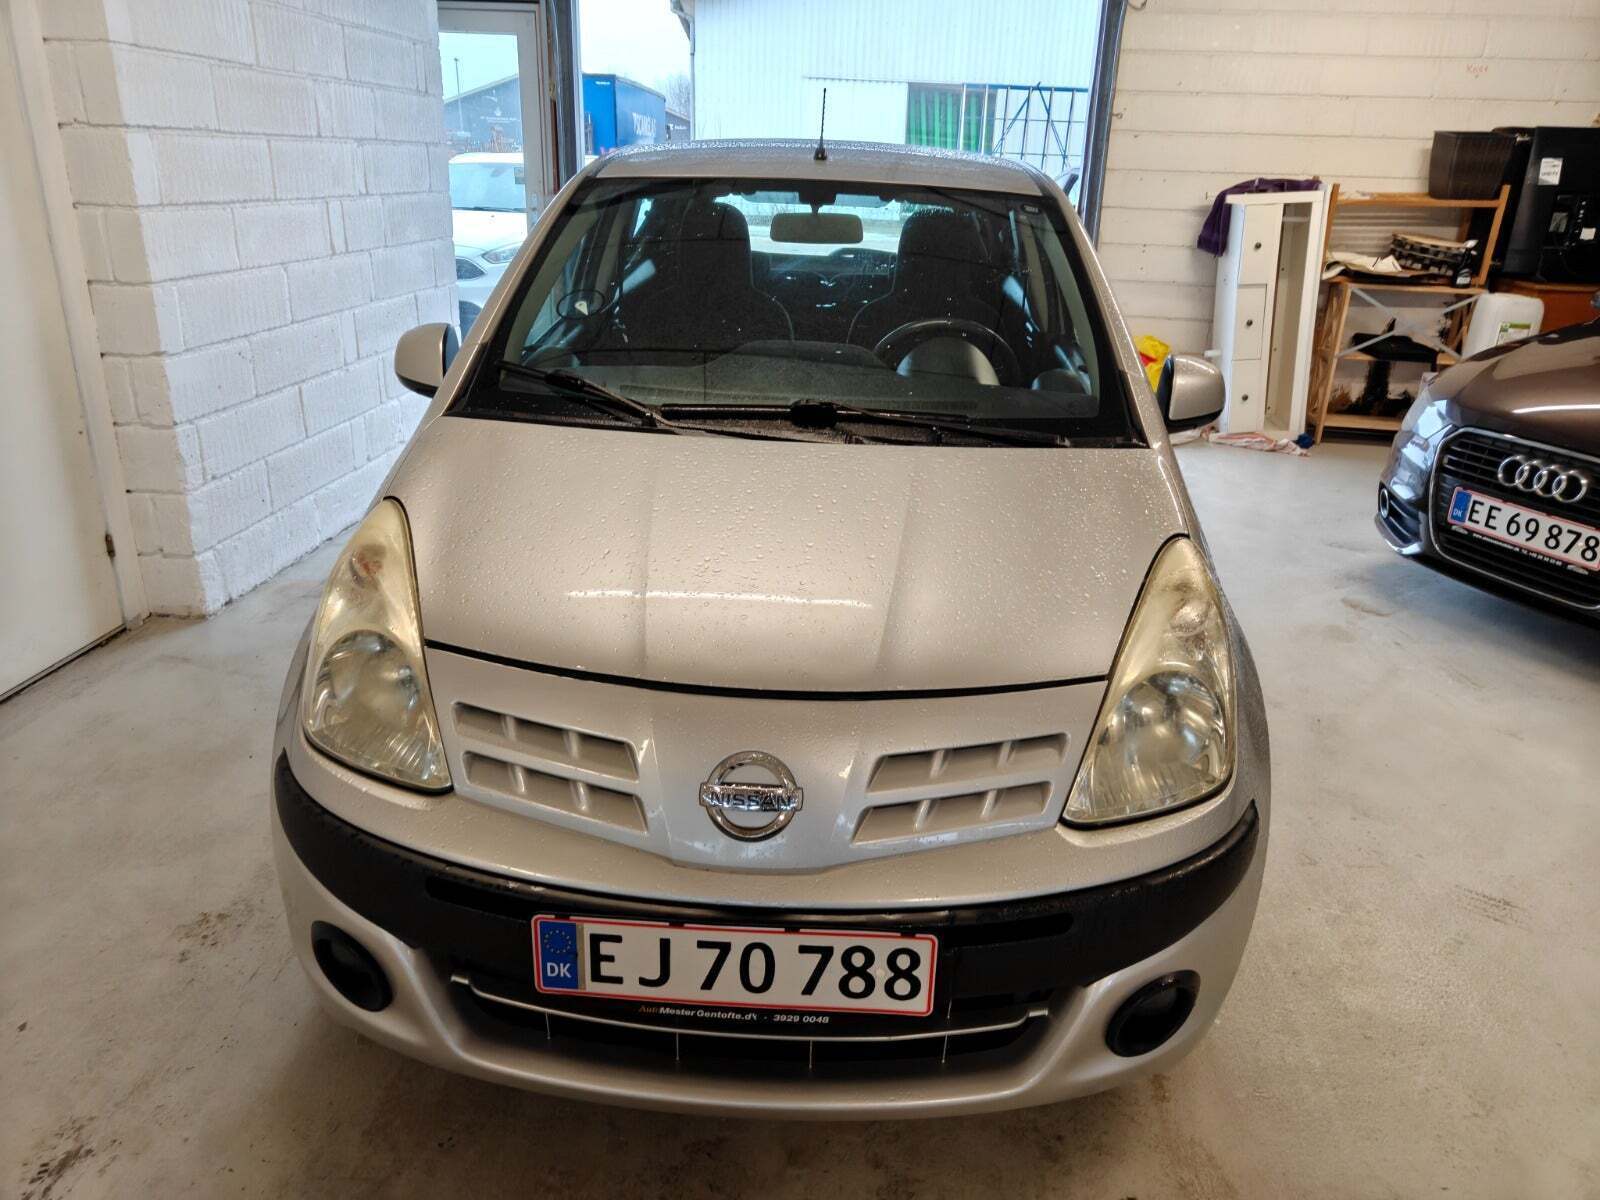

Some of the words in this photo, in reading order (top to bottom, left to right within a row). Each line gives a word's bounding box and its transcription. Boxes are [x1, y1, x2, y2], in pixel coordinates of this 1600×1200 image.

[1468, 499, 1502, 530] EE
[1506, 513, 1540, 542] 69
[1544, 524, 1600, 562] 878
[710, 792, 792, 808] NISSAN
[546, 962, 572, 978] DK
[589, 933, 671, 988] EJ
[697, 940, 776, 994] 70
[798, 945, 922, 1001] 788
[773, 1014, 800, 1023] 3929
[802, 1015, 830, 1024] 0048
